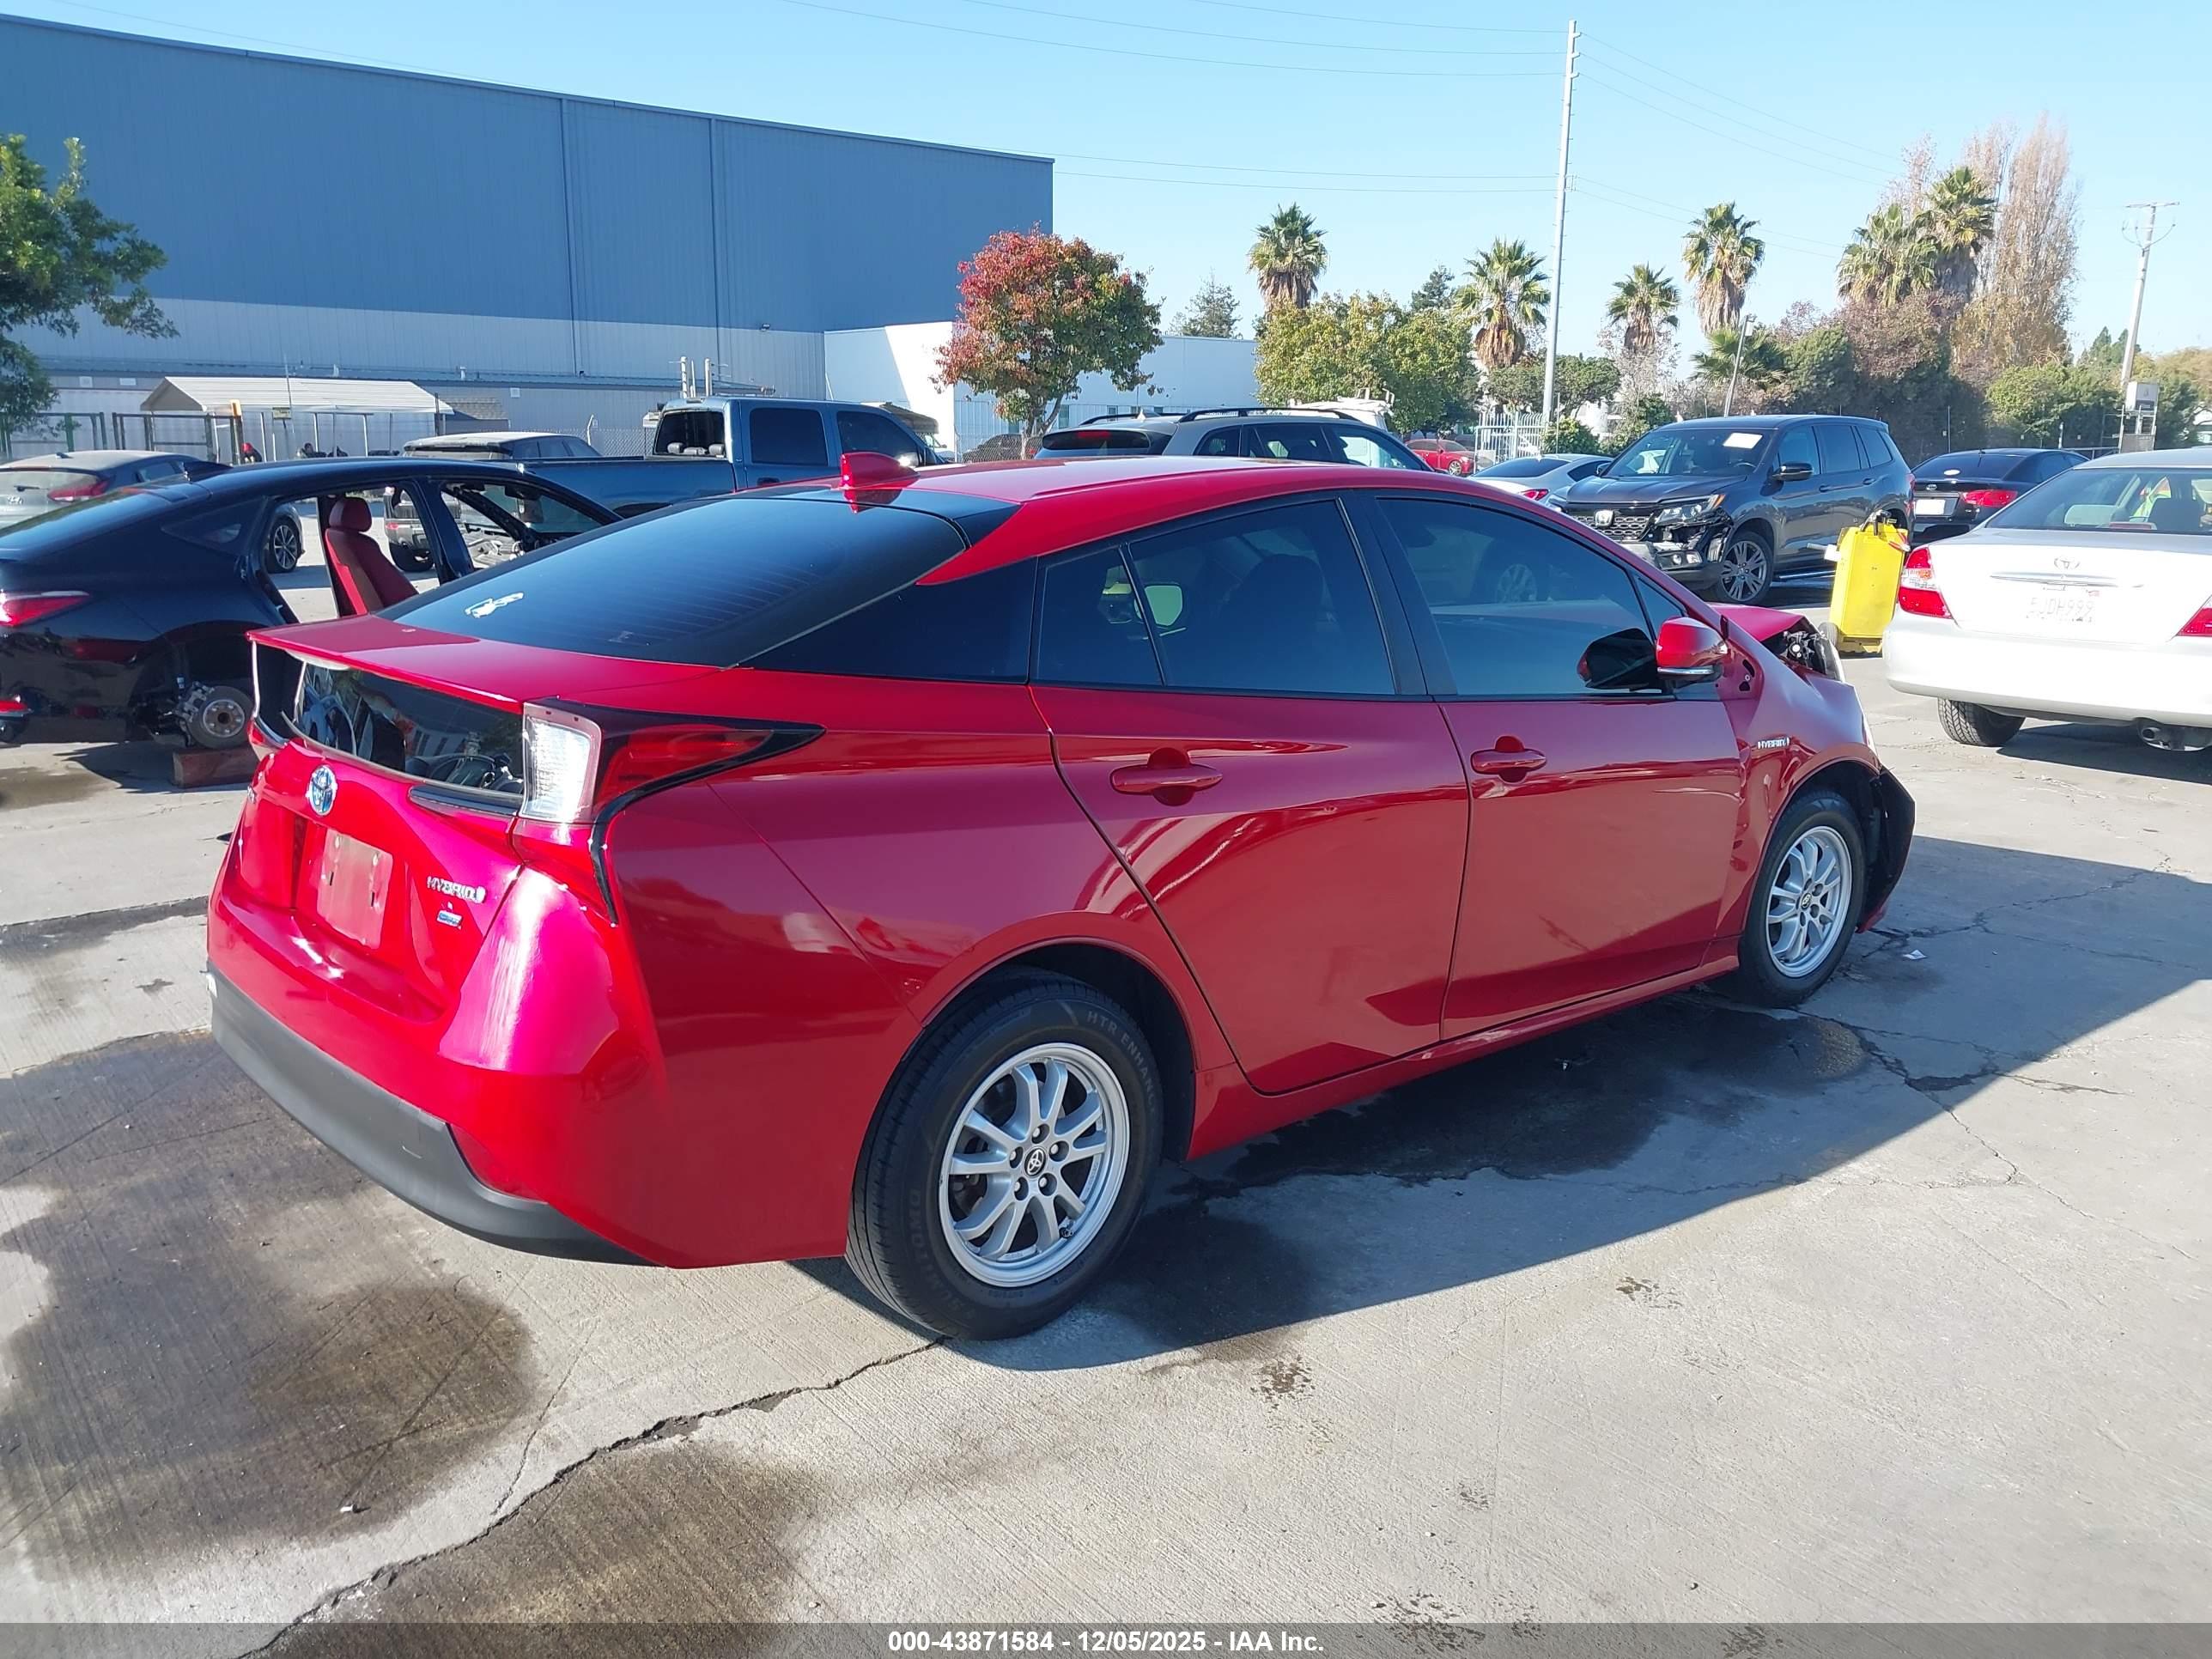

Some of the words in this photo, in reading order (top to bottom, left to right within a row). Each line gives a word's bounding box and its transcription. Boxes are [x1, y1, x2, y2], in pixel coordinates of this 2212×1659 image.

[1757, 738, 1787, 750] HYBRID
[427, 876, 477, 902] HYBRID
[1086, 1010, 1118, 1036] HTR
